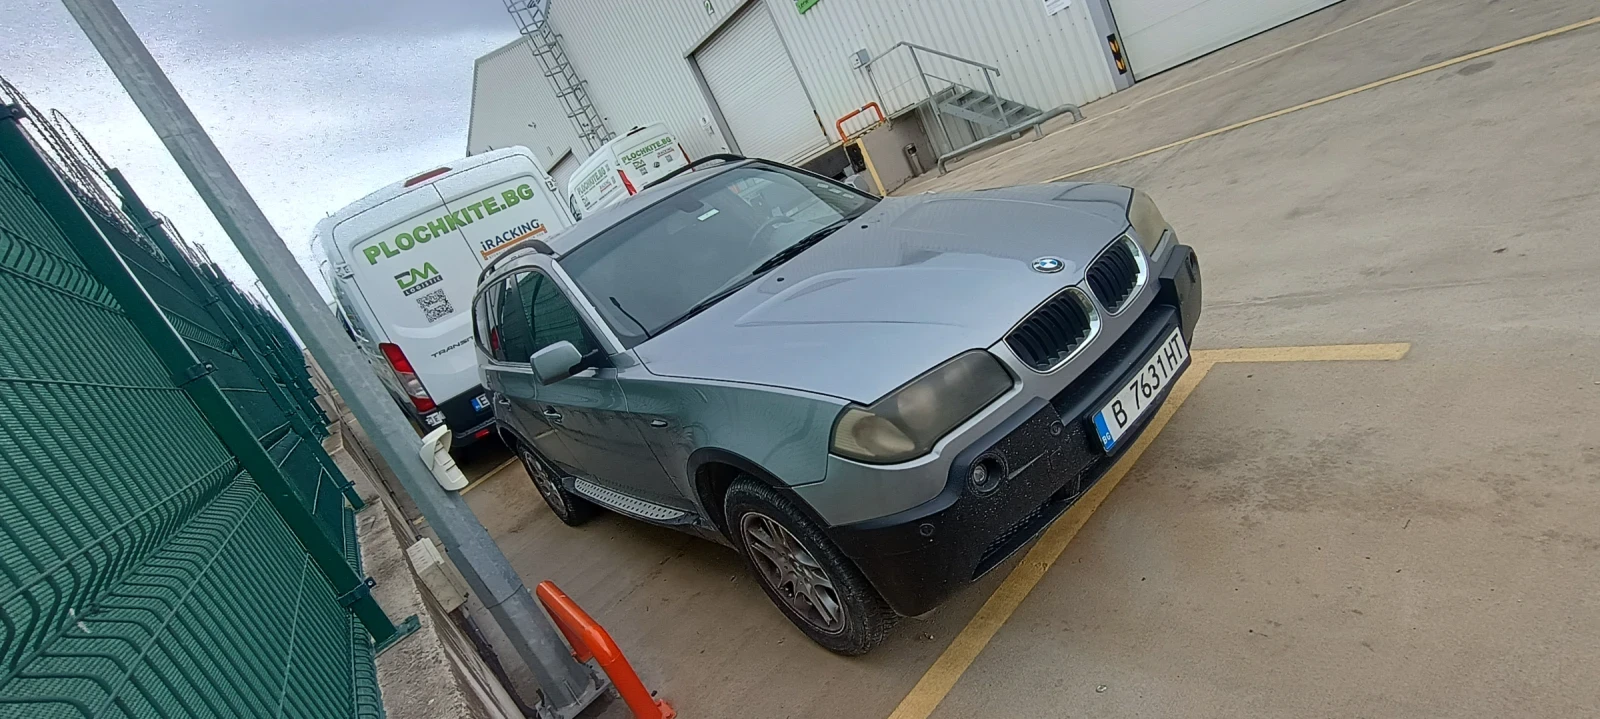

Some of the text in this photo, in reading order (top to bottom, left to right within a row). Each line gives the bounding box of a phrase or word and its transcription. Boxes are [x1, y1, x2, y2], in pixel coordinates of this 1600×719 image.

[704, 1, 714, 16] 2
[621, 136, 672, 164] PLOCHKITE.BG
[363, 183, 535, 266] PLOCHKITE.BG
[480, 218, 540, 252] iRACKING
[394, 262, 439, 289] DM
[404, 275, 443, 296] LOGISTIC
[1102, 431, 1112, 445] BG
